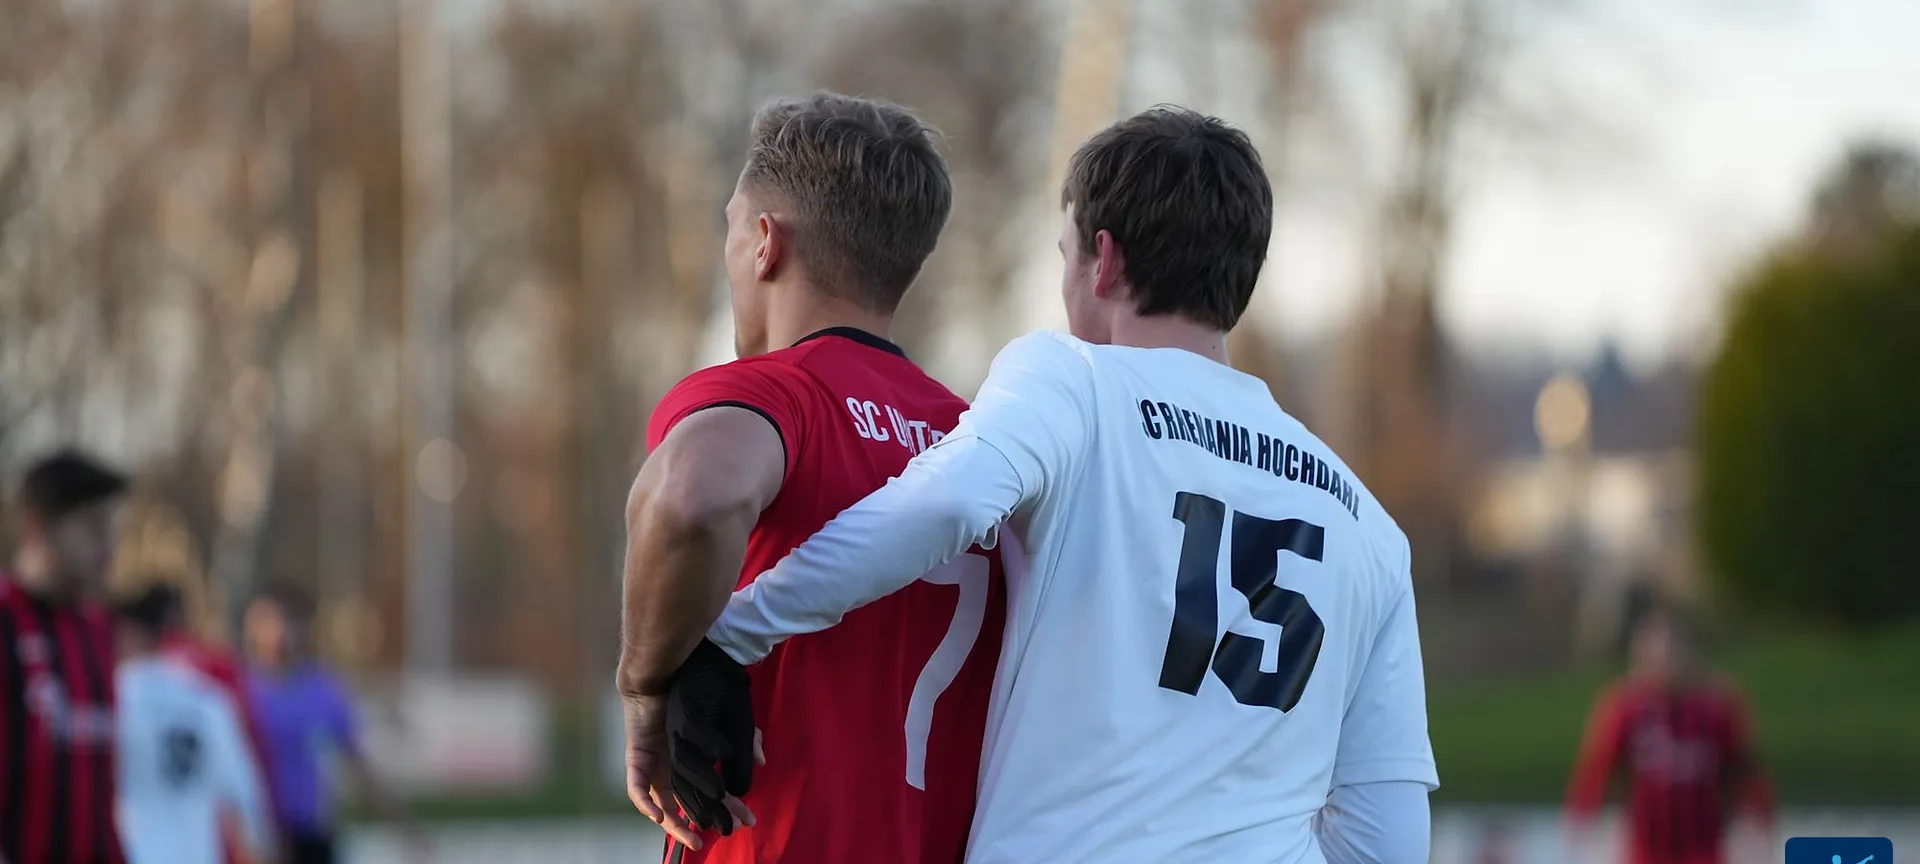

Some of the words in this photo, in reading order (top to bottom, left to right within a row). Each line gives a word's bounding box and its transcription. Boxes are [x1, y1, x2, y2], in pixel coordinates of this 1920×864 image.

[846, 397, 889, 441] SC
[1136, 398, 1162, 440] C
[1257, 432, 1359, 521] HOCHDAHL
[904, 552, 990, 791] 7
[1158, 490, 1325, 713] 15
